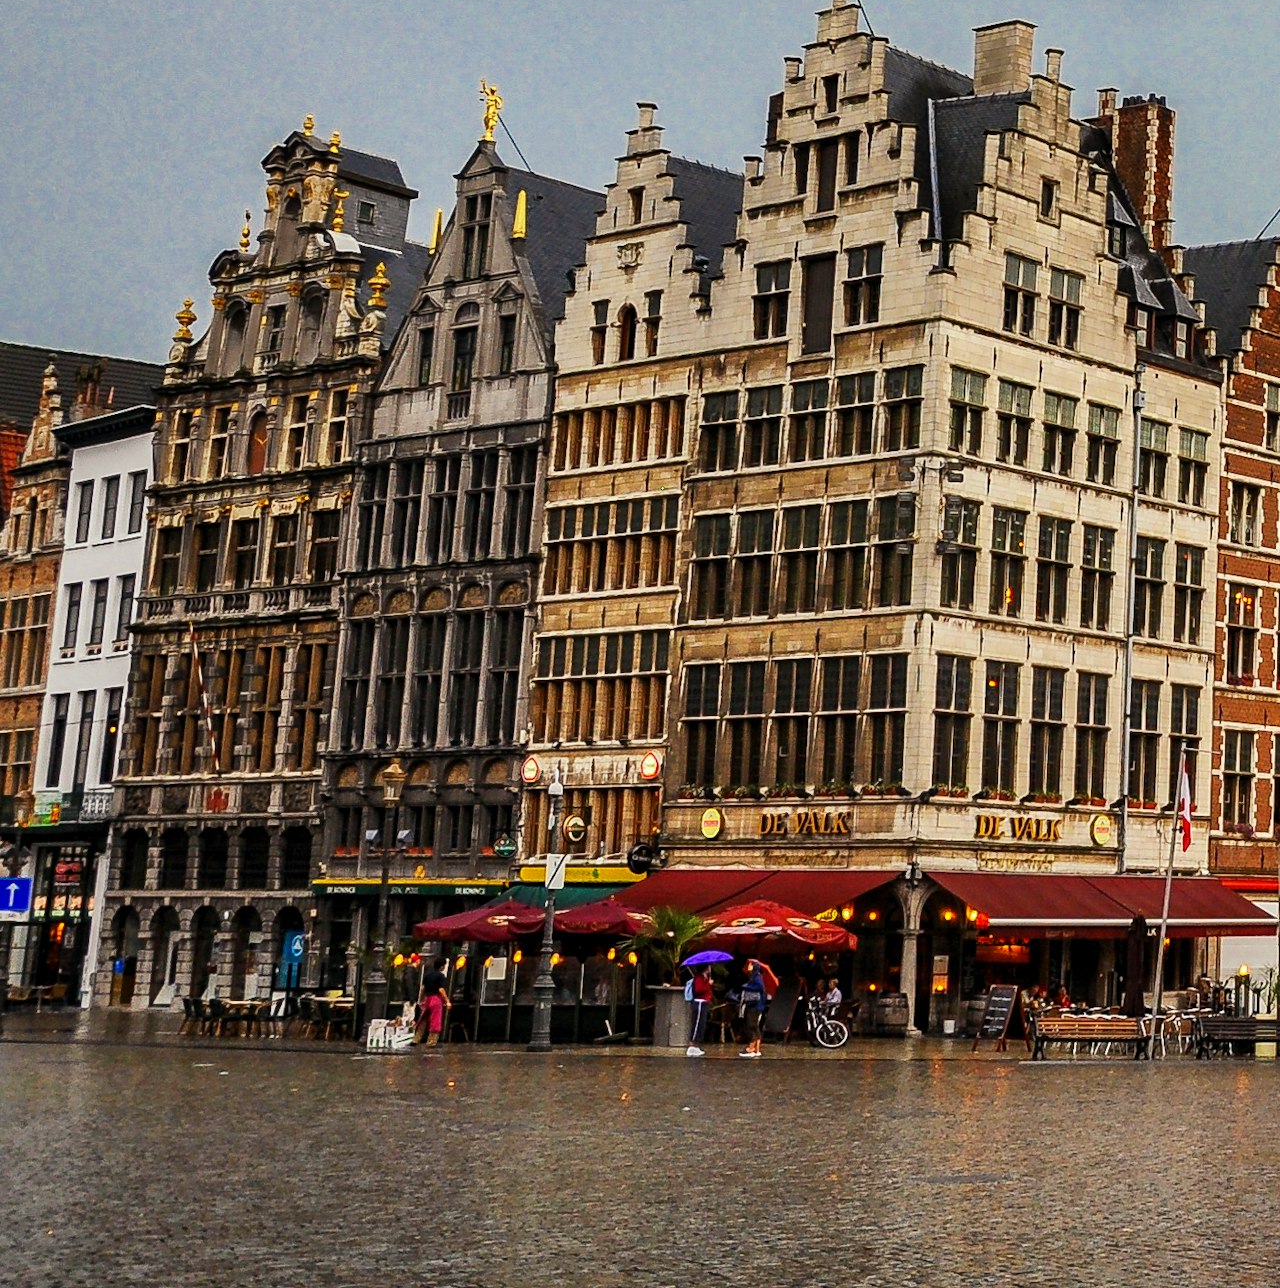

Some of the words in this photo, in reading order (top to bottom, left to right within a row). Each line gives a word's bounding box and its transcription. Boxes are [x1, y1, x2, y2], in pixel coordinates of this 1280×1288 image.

[757, 811, 789, 836] DE
[793, 810, 850, 835] VALK
[977, 814, 1006, 839] DE
[1011, 816, 1064, 841] VALK
